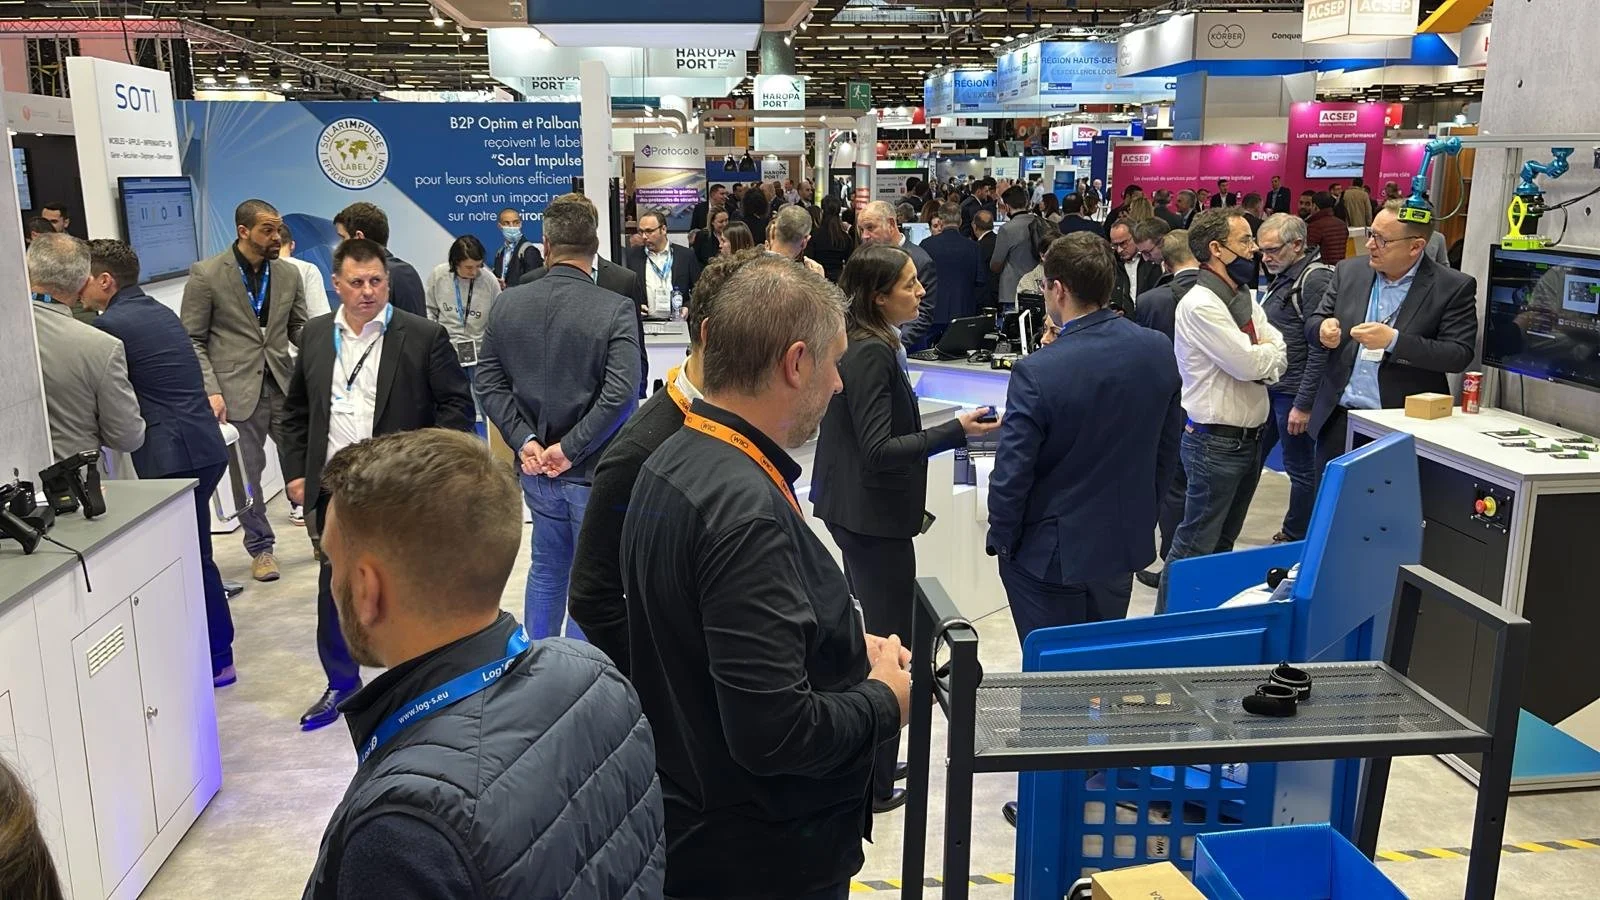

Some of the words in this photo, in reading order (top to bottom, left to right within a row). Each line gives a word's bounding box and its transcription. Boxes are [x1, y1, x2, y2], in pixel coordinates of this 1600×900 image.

[1309, 0, 1345, 20] ACSEP
[1360, 0, 1411, 12] ACSEP
[1211, 31, 1242, 40] KÖRBER
[676, 48, 736, 57] HAROPA
[676, 59, 717, 69] PORT
[532, 82, 565, 90] PORT
[115, 84, 157, 113] SOTI
[1322, 112, 1355, 120] ACSEP
[451, 117, 474, 129] B2P
[478, 116, 518, 132] Optim
[522, 118, 533, 129] et
[484, 137, 536, 149] reçoivent
[540, 134, 551, 147] le
[652, 146, 699, 156] Protocole
[322, 159, 355, 185] EFFICIENT
[357, 159, 385, 185] SOLUTION
[415, 177, 442, 189] pour
[446, 172, 472, 185] leurs
[475, 172, 525, 185] solutions
[528, 172, 573, 185] efficient
[456, 192, 488, 206] ayant
[492, 194, 505, 203] un
[510, 191, 548, 206] impact
[449, 211, 464, 221] sur
[469, 209, 497, 221] notre
[398, 690, 449, 724] www.log-s.eu
